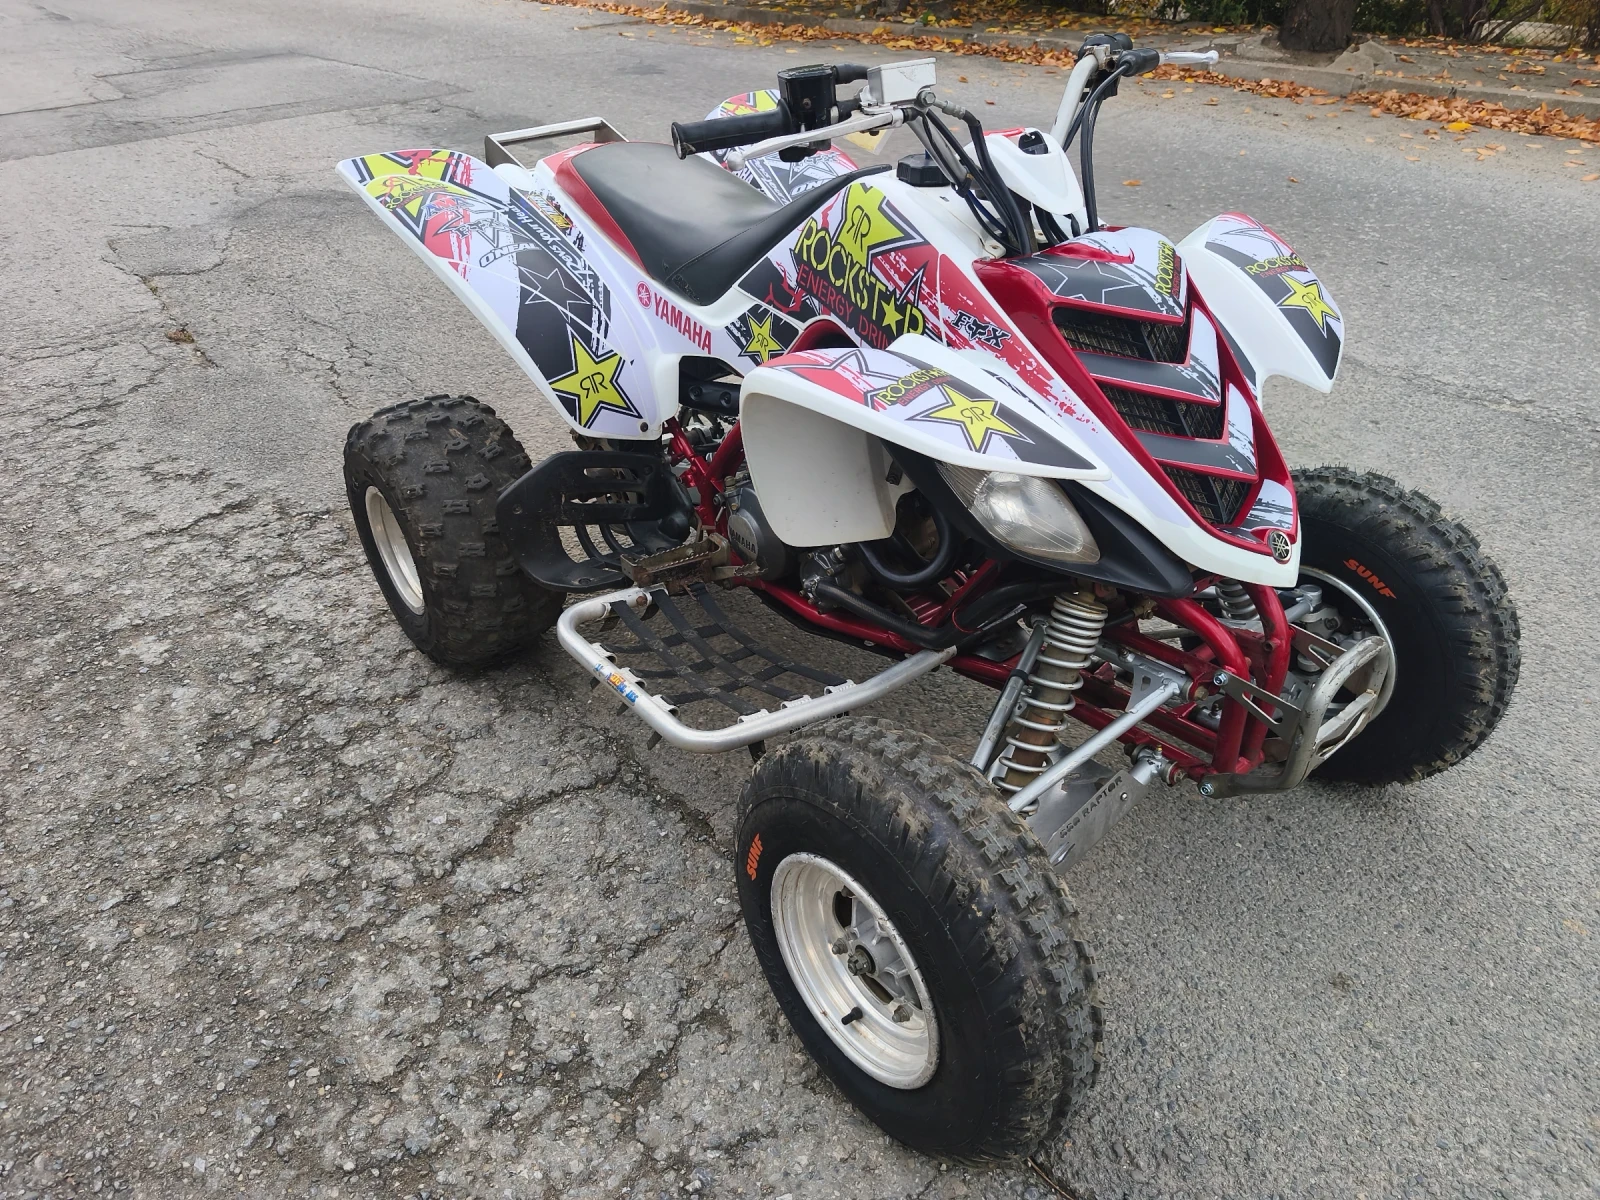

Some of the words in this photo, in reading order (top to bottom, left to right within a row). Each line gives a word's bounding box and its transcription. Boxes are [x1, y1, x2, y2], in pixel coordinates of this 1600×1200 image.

[653, 292, 712, 355] YAMAHA
[797, 263, 854, 323] ENERGY
[858, 314, 890, 350] DRIN
[1081, 775, 1123, 818] RAPTOR
